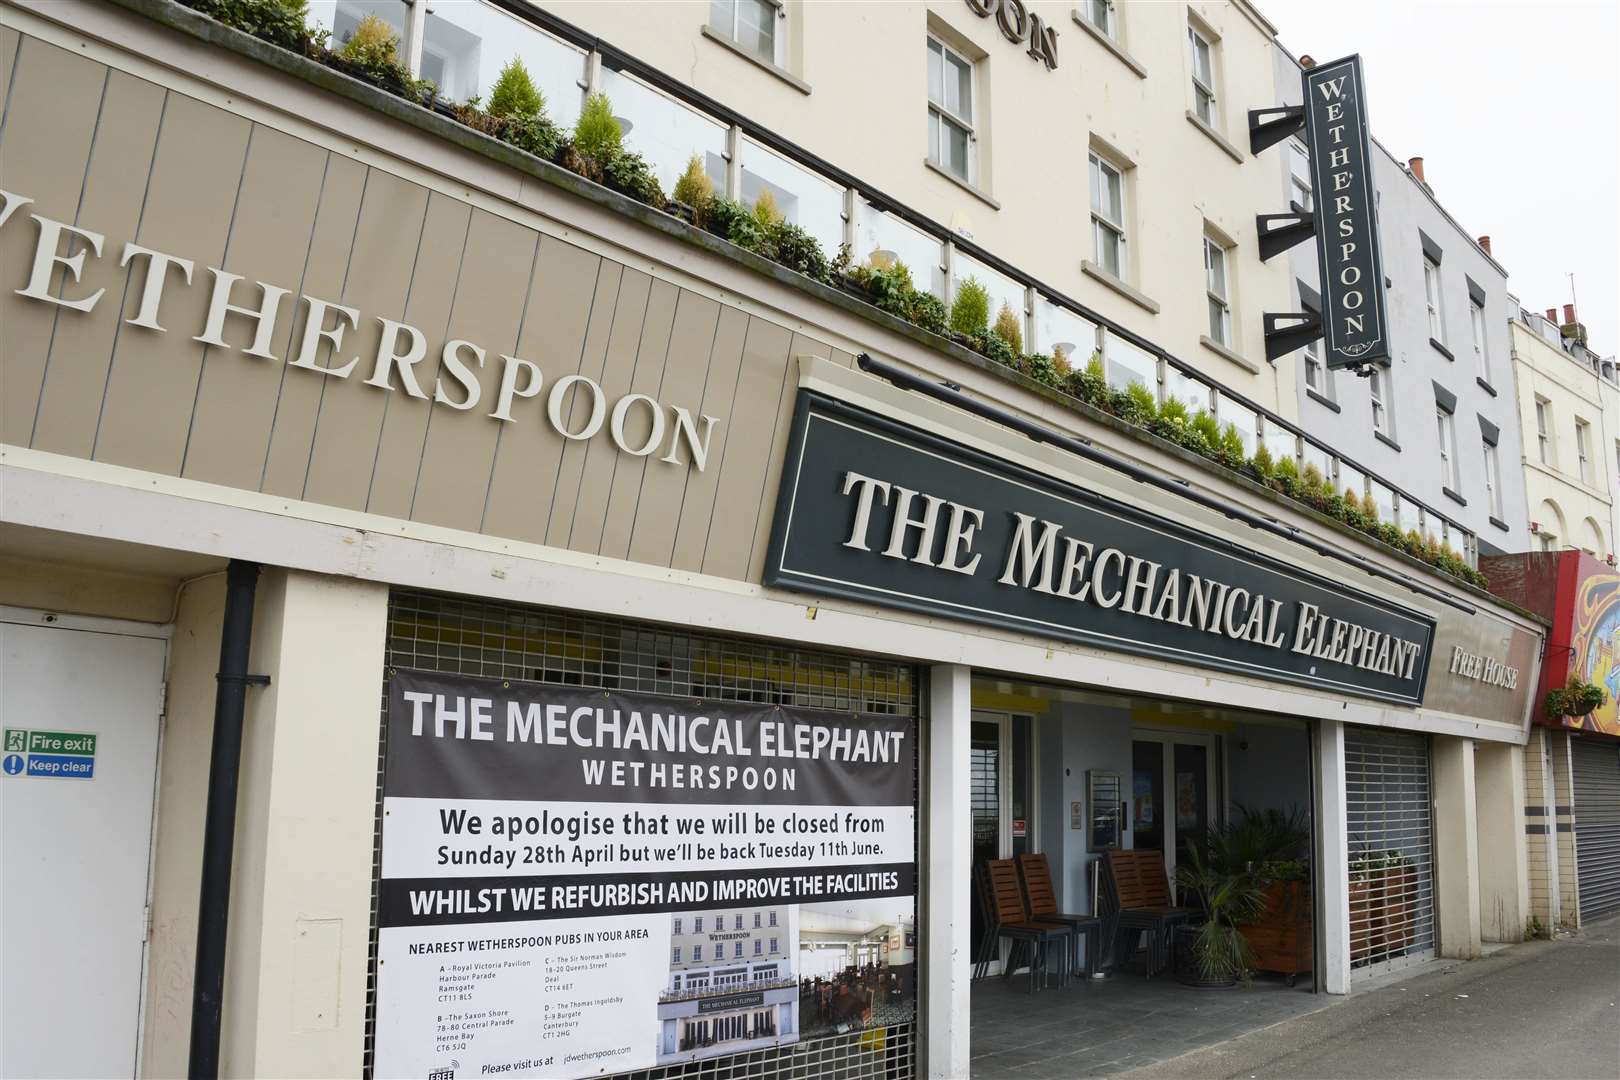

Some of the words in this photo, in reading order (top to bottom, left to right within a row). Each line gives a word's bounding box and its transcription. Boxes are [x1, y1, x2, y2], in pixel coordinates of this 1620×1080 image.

[1317, 76, 1365, 336] WETHERSPOON
[842, 472, 984, 576] THE
[998, 512, 1285, 648] MECHANICAL
[1291, 601, 1420, 680] ELEPHANT
[1450, 645, 1482, 679] FREE
[1482, 656, 1519, 689] HOUSE
[404, 691, 494, 741] THE
[506, 701, 752, 756] MECHANICAL
[760, 721, 905, 763] ELEPHANT
[31, 735, 62, 749] Fire
[64, 738, 94, 751] exit
[29, 760, 60, 774] Keep
[62, 761, 92, 772] clear
[582, 759, 796, 791] WETHERSPOON
[440, 809, 482, 835] We
[492, 810, 614, 841] apologise
[623, 811, 669, 835] that
[677, 818, 705, 835] we
[712, 812, 747, 835] will
[755, 812, 775, 834] be
[782, 813, 839, 834] closed
[845, 813, 885, 833] from
[437, 845, 516, 869] Sunday
[523, 845, 565, 864] 28th
[572, 844, 613, 867] April
[620, 843, 649, 862] but
[654, 843, 691, 861] we'll
[697, 843, 715, 860] be
[720, 842, 755, 859] back
[759, 842, 815, 860] Tuesday
[820, 841, 848, 857] 11th
[852, 841, 884, 855] June.
[409, 888, 506, 916] WHILST
[511, 887, 546, 911] WE
[551, 883, 663, 909] REFURBISH
[667, 881, 709, 903] AND
[713, 877, 791, 901] IMPROVE
[793, 874, 823, 896] THE
[826, 871, 898, 894] FACILITIES
[409, 941, 465, 955] NEAREST
[468, 936, 552, 952] WETHERSPOON
[555, 933, 581, 945] PUBS
[584, 932, 594, 943] IN
[597, 931, 622, 941] YOUR
[624, 929, 649, 939] AREA
[580, 953, 603, 961] Norman
[474, 961, 502, 970] Victoria
[503, 959, 531, 968] Pavilion
[589, 962, 608, 970] Street
[439, 974, 470, 982] Harbour
[472, 972, 496, 980] Parade
[438, 984, 475, 993] Ramsgate
[438, 994, 457, 1002] CT11
[570, 1000, 593, 1008] Thomas
[557, 1010, 582, 1019] Burgate
[461, 1020, 488, 1030] Central
[490, 1018, 514, 1027] Parade
[543, 1020, 579, 1030] Canterbury
[437, 1034, 459, 1042] Herne
[461, 1032, 475, 1040] Bay
[436, 1044, 450, 1052] CT6
[481, 1064, 511, 1074] Please
[513, 1059, 531, 1070] visit
[533, 1058, 543, 1067] us
[544, 1056, 554, 1065] at
[563, 1046, 631, 1064] jdwetherspoon.com
